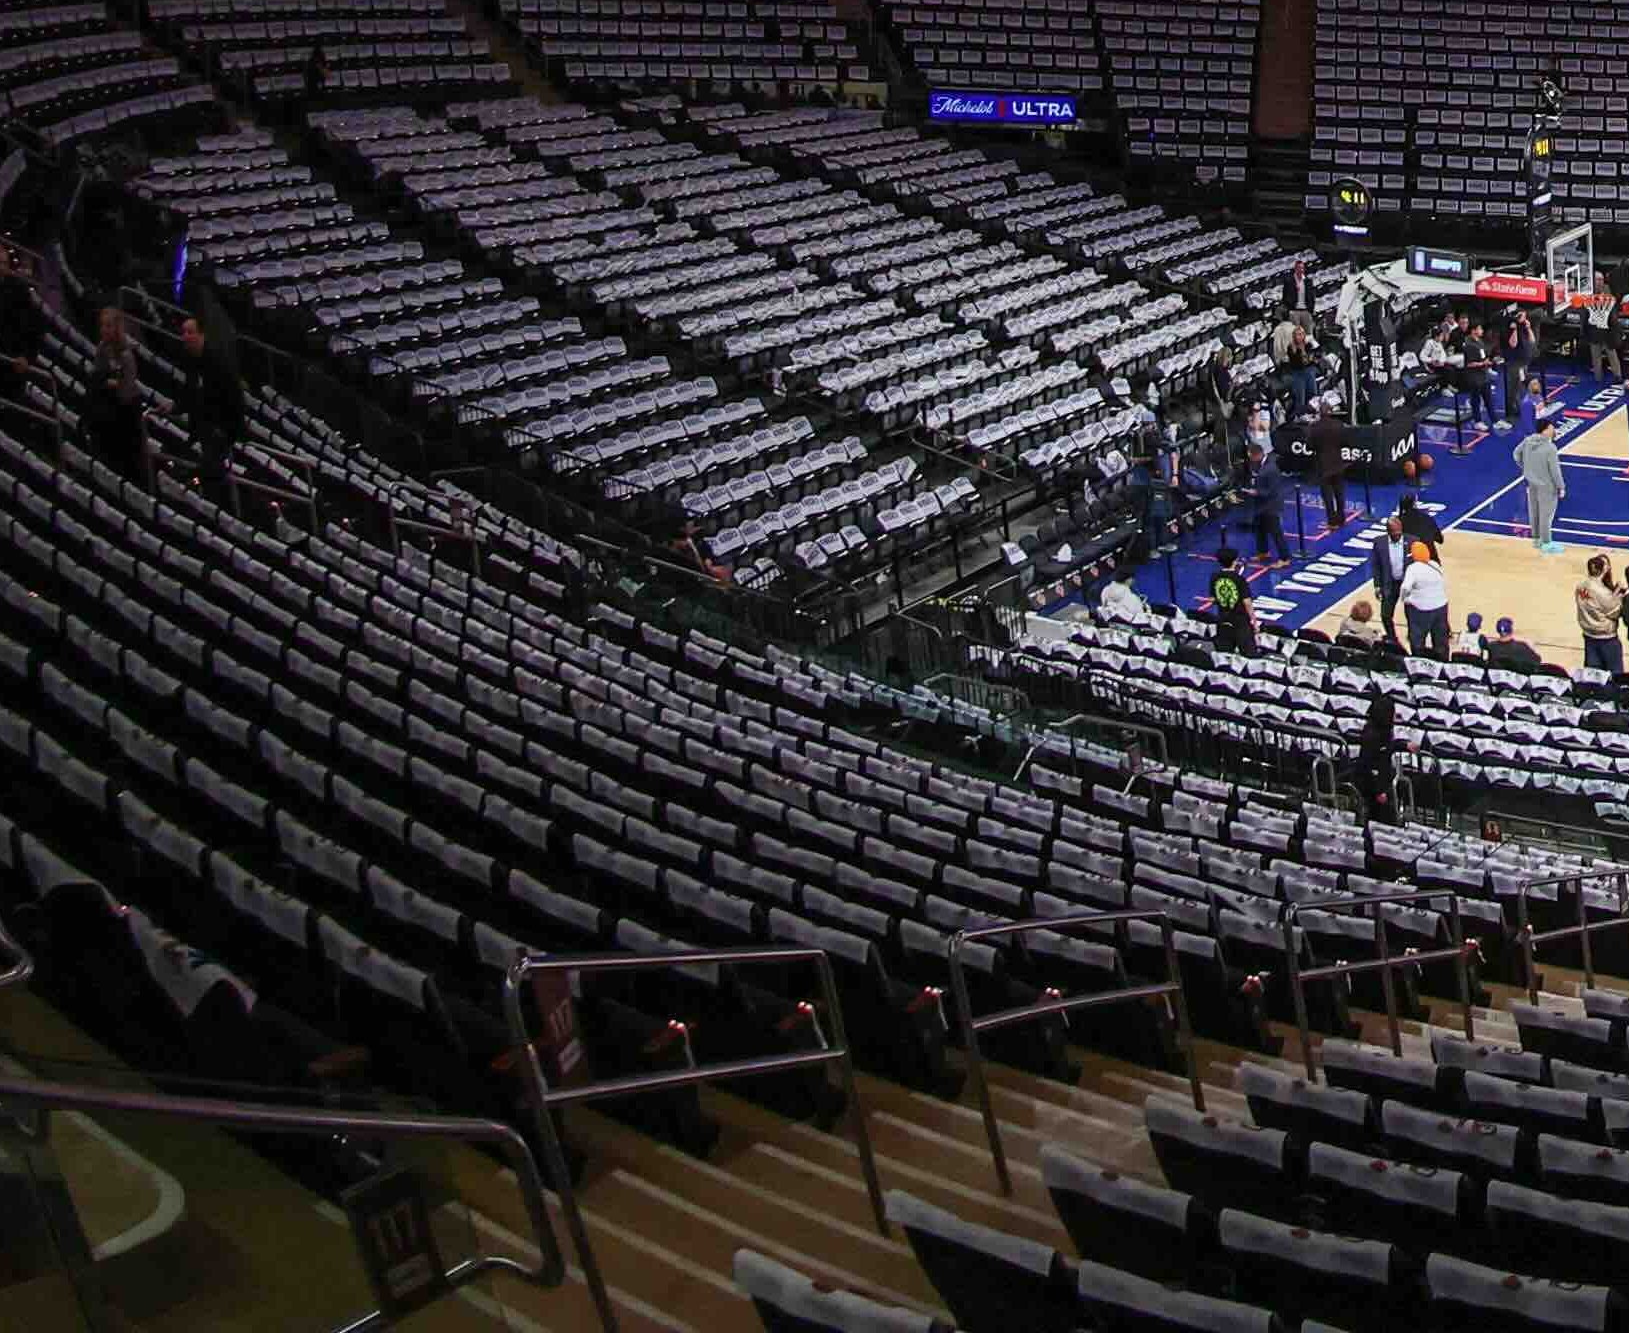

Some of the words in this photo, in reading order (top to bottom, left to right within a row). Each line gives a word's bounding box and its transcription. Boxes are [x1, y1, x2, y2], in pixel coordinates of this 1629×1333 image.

[1012, 100, 1074, 118] ULTRA
[1577, 384, 1626, 412] ULTR
[1274, 552, 1369, 594] YORK
[1253, 595, 1299, 621] EW
